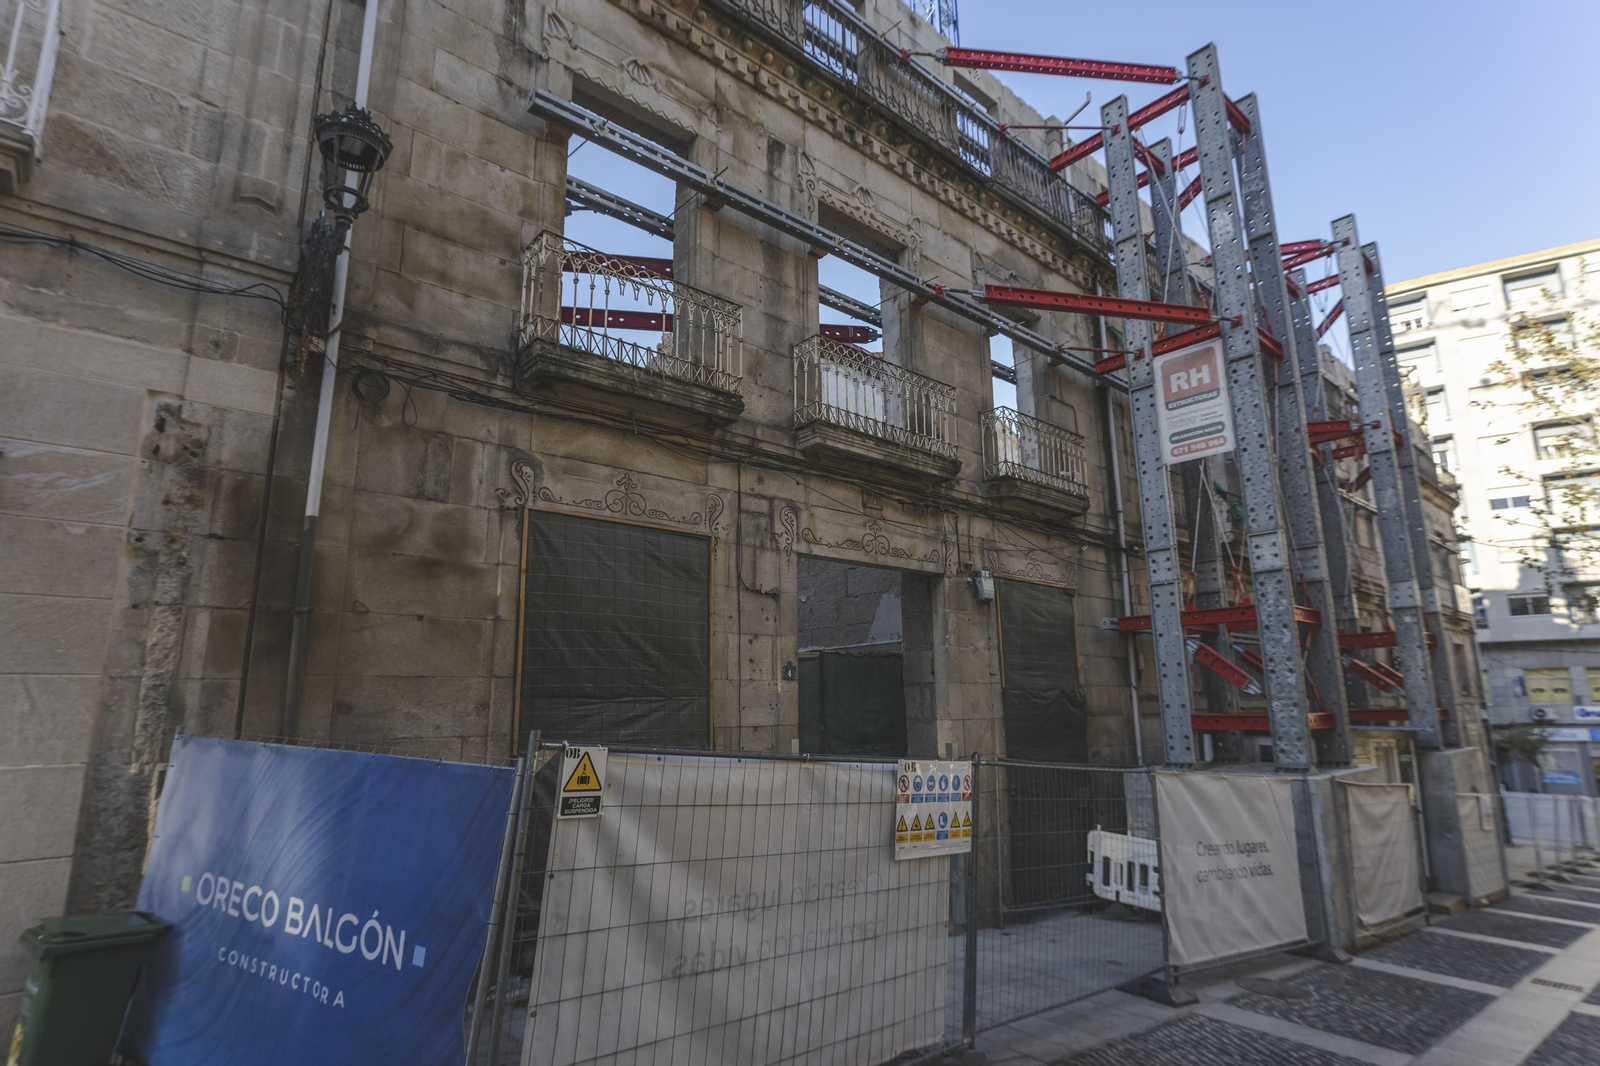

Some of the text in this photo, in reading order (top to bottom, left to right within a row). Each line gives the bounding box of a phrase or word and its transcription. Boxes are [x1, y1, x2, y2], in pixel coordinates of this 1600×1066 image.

[1168, 391, 1218, 409] ESTRUCTURAS
[1169, 364, 1210, 394] RH
[196, 871, 406, 970] ORECO BALGÓN
[218, 946, 345, 1009] CONSTRUCTORA
